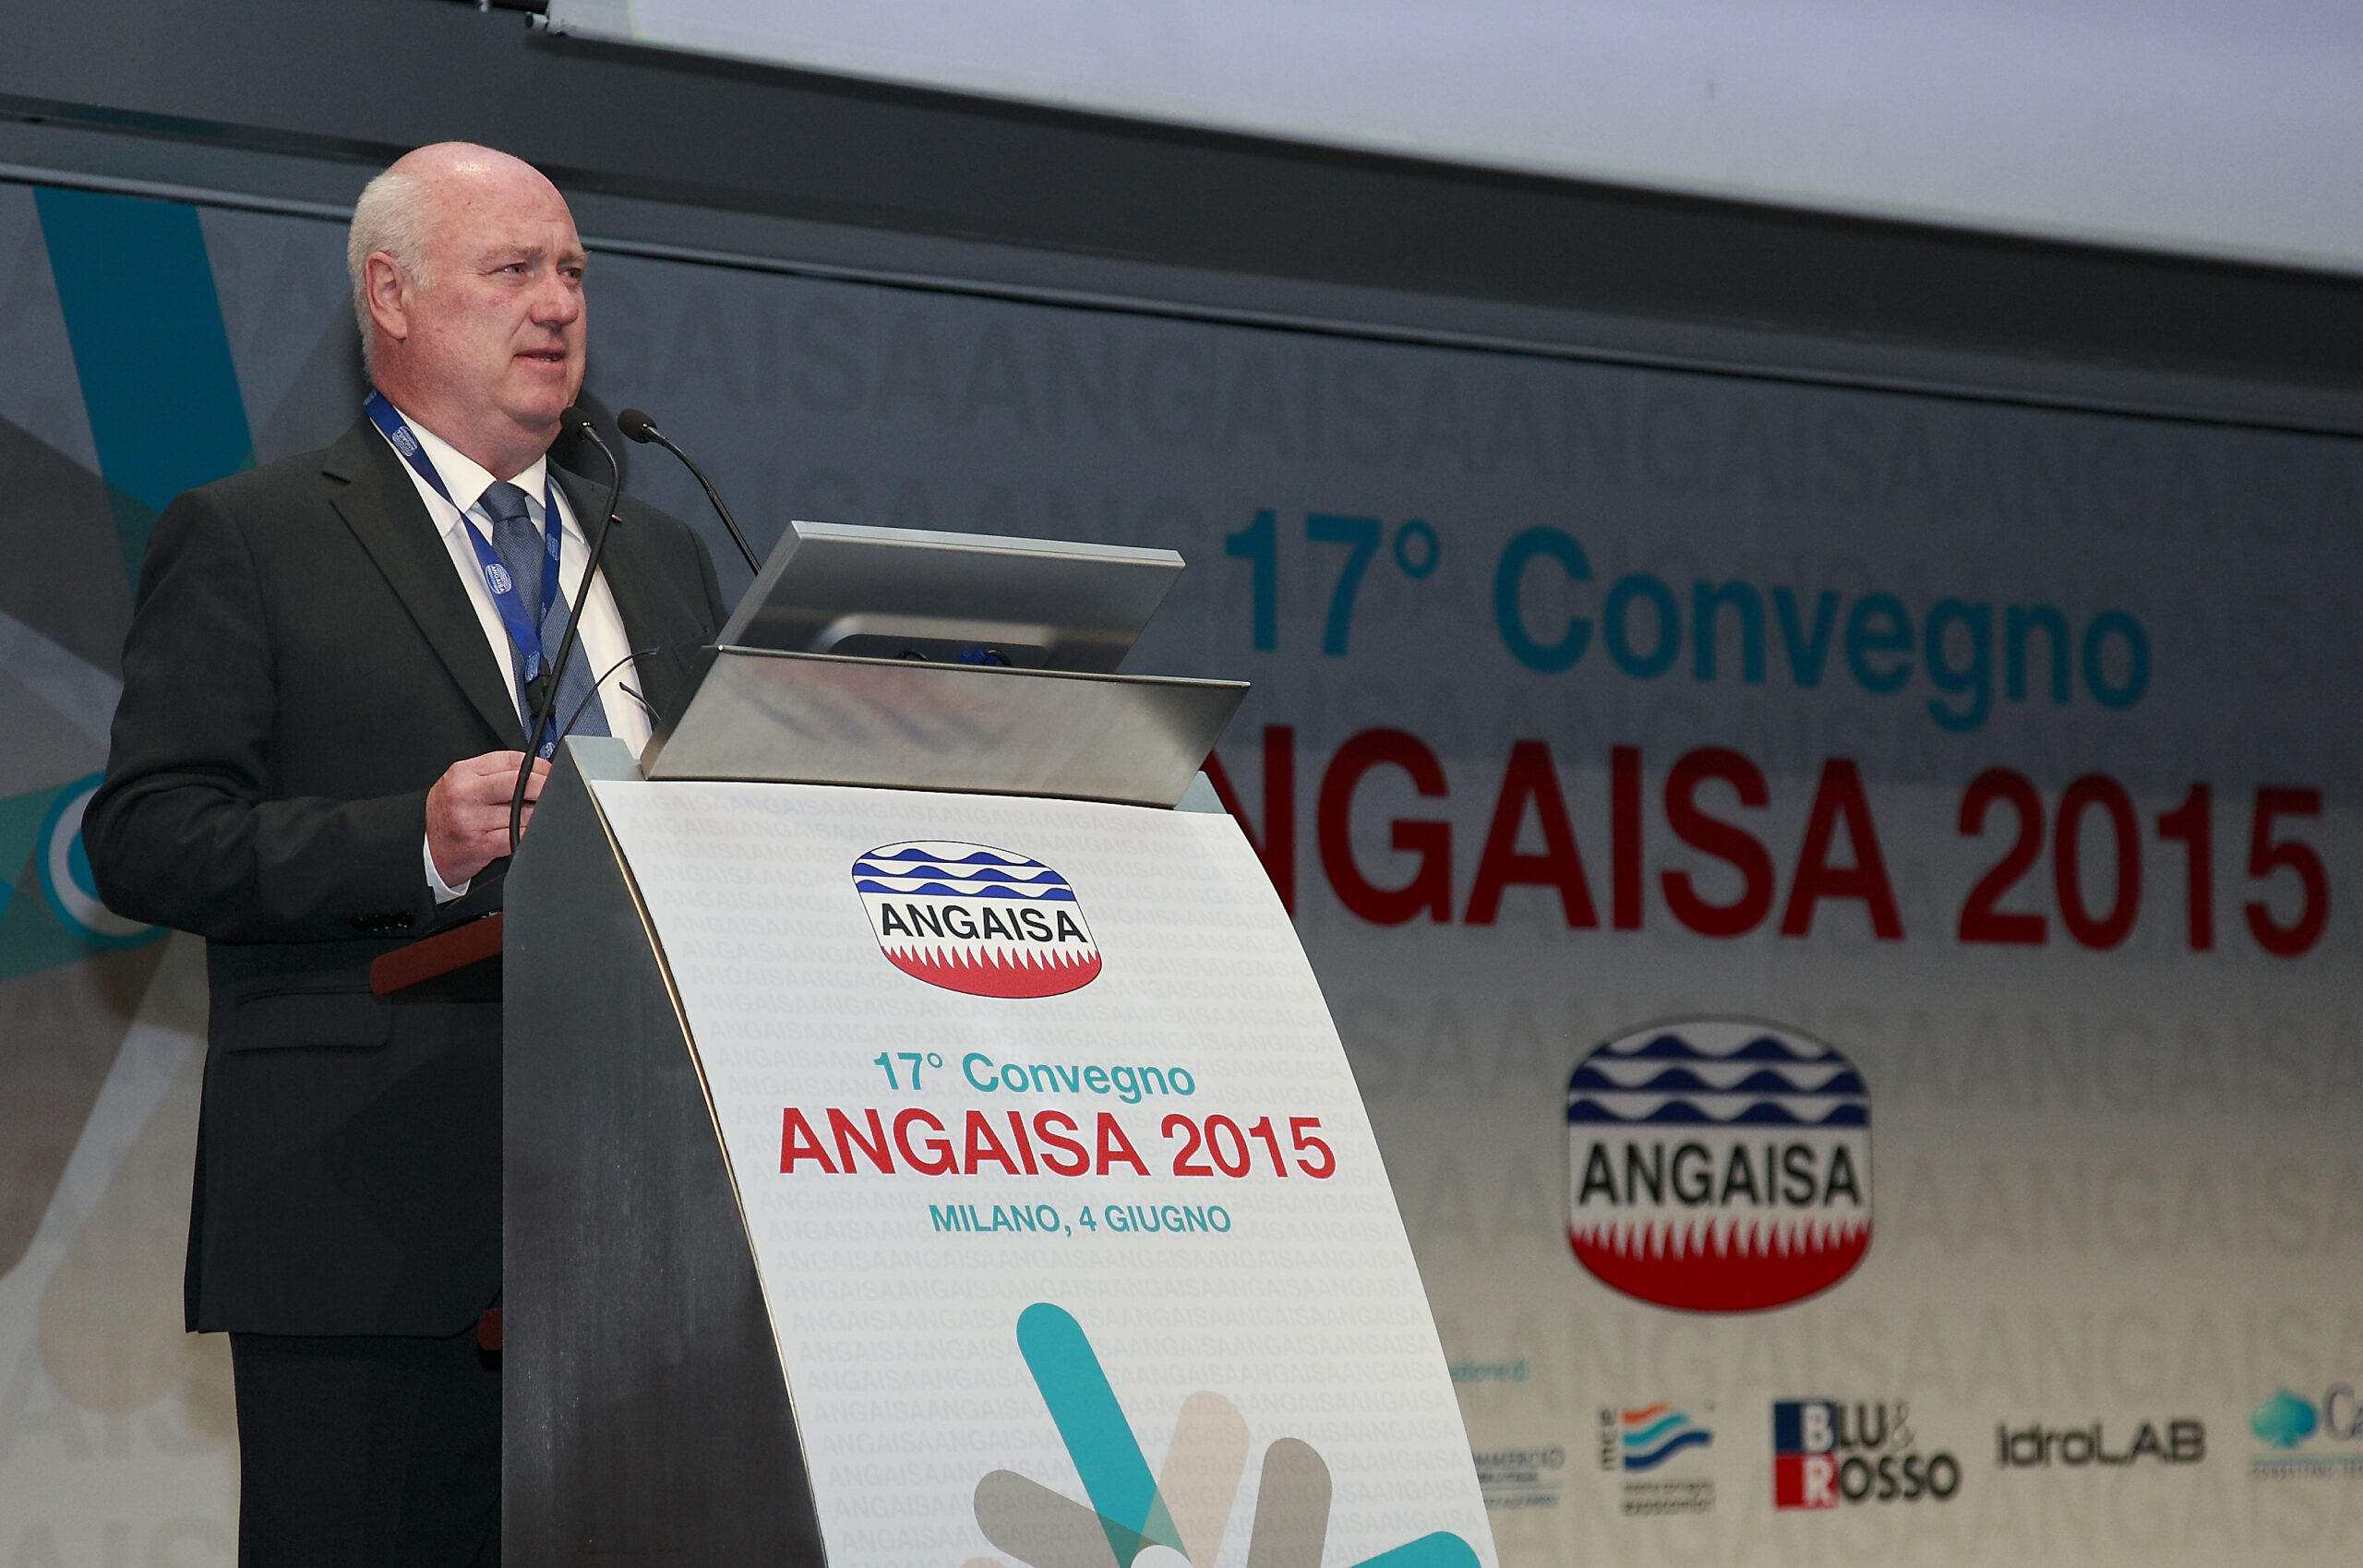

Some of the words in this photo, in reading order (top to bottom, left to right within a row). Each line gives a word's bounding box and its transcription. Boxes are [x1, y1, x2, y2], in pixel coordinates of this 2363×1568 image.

[1223, 508, 1442, 659] 17°
[1491, 523, 2154, 736] Convegno
[1199, 724, 1905, 941] NGAISA
[1958, 768, 2331, 959] 2015
[882, 901, 1088, 944] ANGAISA
[874, 1052, 942, 1090] 17°
[962, 1052, 1195, 1104] Convegno
[779, 1107, 1151, 1178] ANGAISA
[1162, 1113, 1336, 1179] 2015
[1577, 1140, 1864, 1208] ANGAISA
[930, 1204, 1072, 1236] MILANO,
[1079, 1206, 1098, 1232] 4
[1104, 1204, 1232, 1233] GIUGNO
[1997, 1417, 2207, 1469] IdroLAB
[1803, 1454, 1961, 1507] ROSSO
